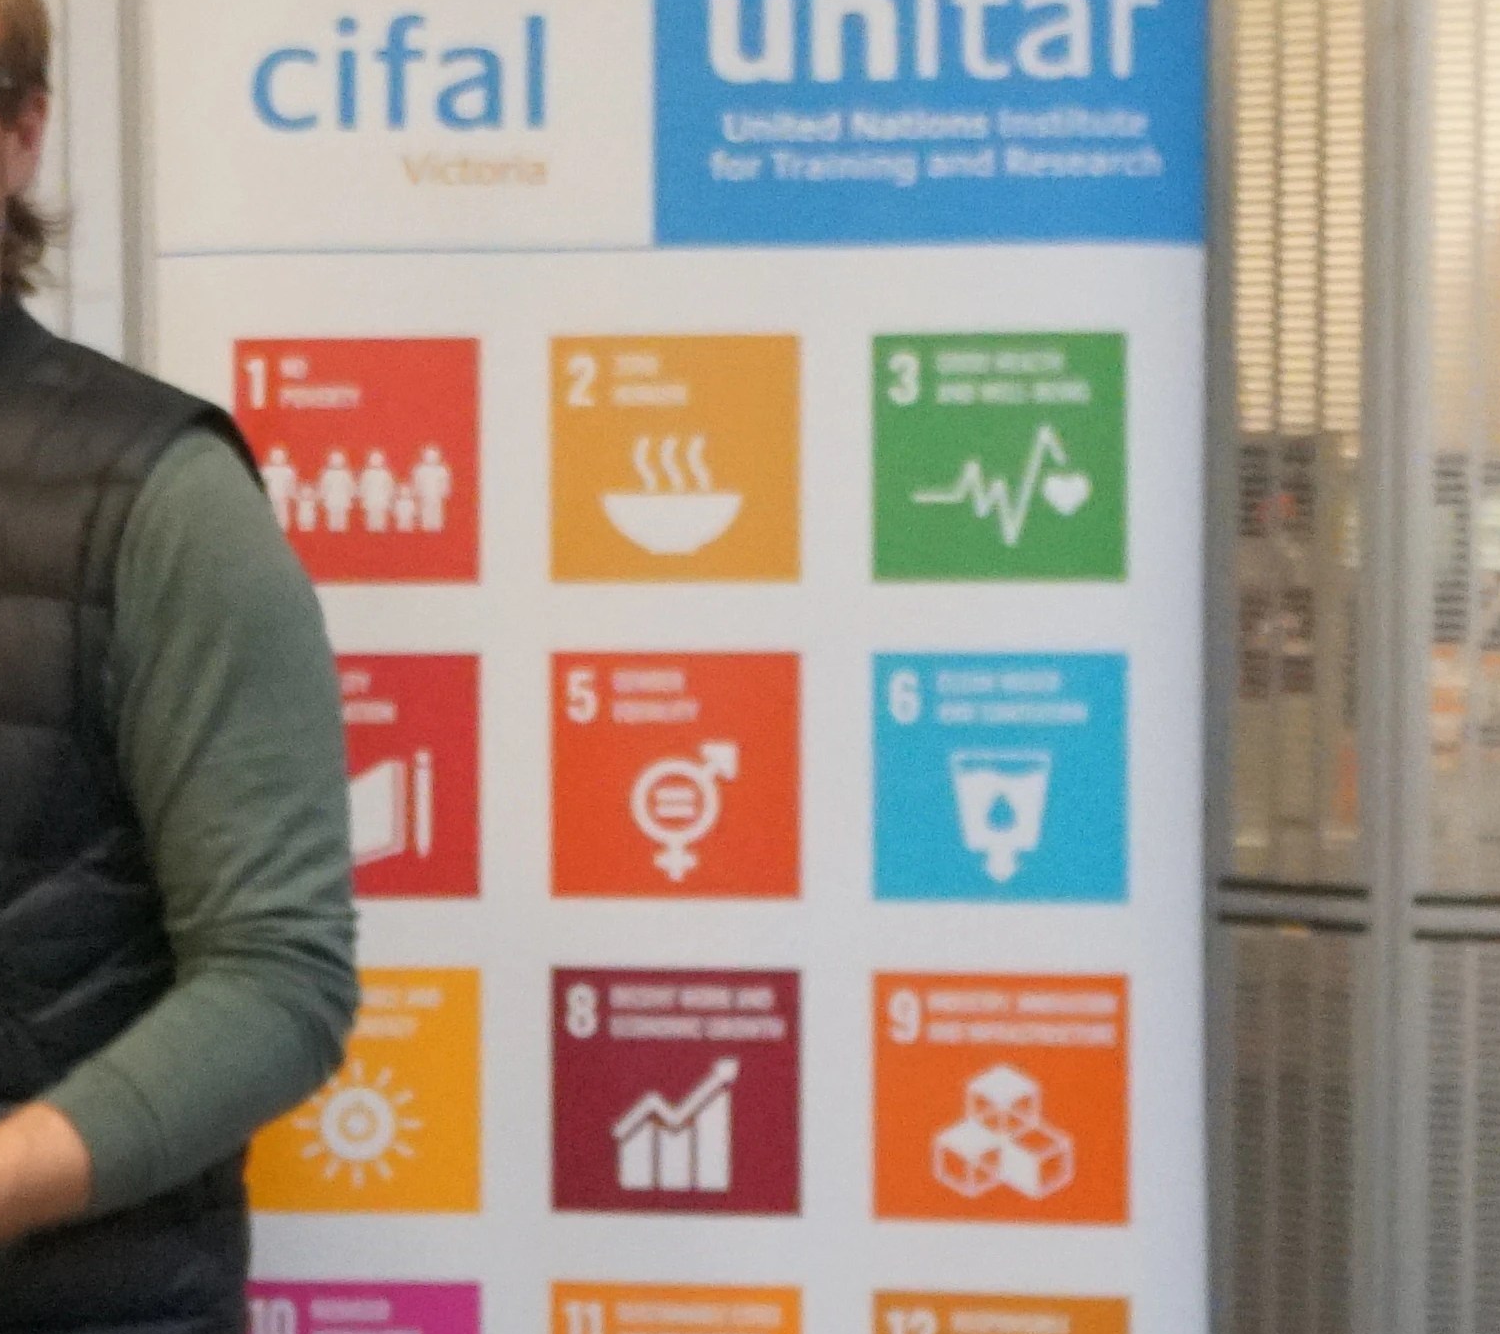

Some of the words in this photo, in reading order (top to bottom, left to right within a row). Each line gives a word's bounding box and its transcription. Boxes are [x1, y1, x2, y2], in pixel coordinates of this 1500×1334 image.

[250, 13, 547, 131] cifal
[721, 111, 841, 143] United
[850, 110, 988, 140] Nations
[401, 154, 549, 186] Victoria
[710, 148, 760, 181] for
[771, 147, 918, 187] Training
[926, 147, 995, 178] and
[1004, 144, 1163, 177] Research
[245, 357, 267, 410] 1
[565, 354, 599, 408] 2
[887, 351, 921, 406] 3
[564, 668, 599, 723] 5
[887, 669, 921, 724] 6
[564, 982, 598, 1039] 8
[888, 988, 921, 1044] 9
